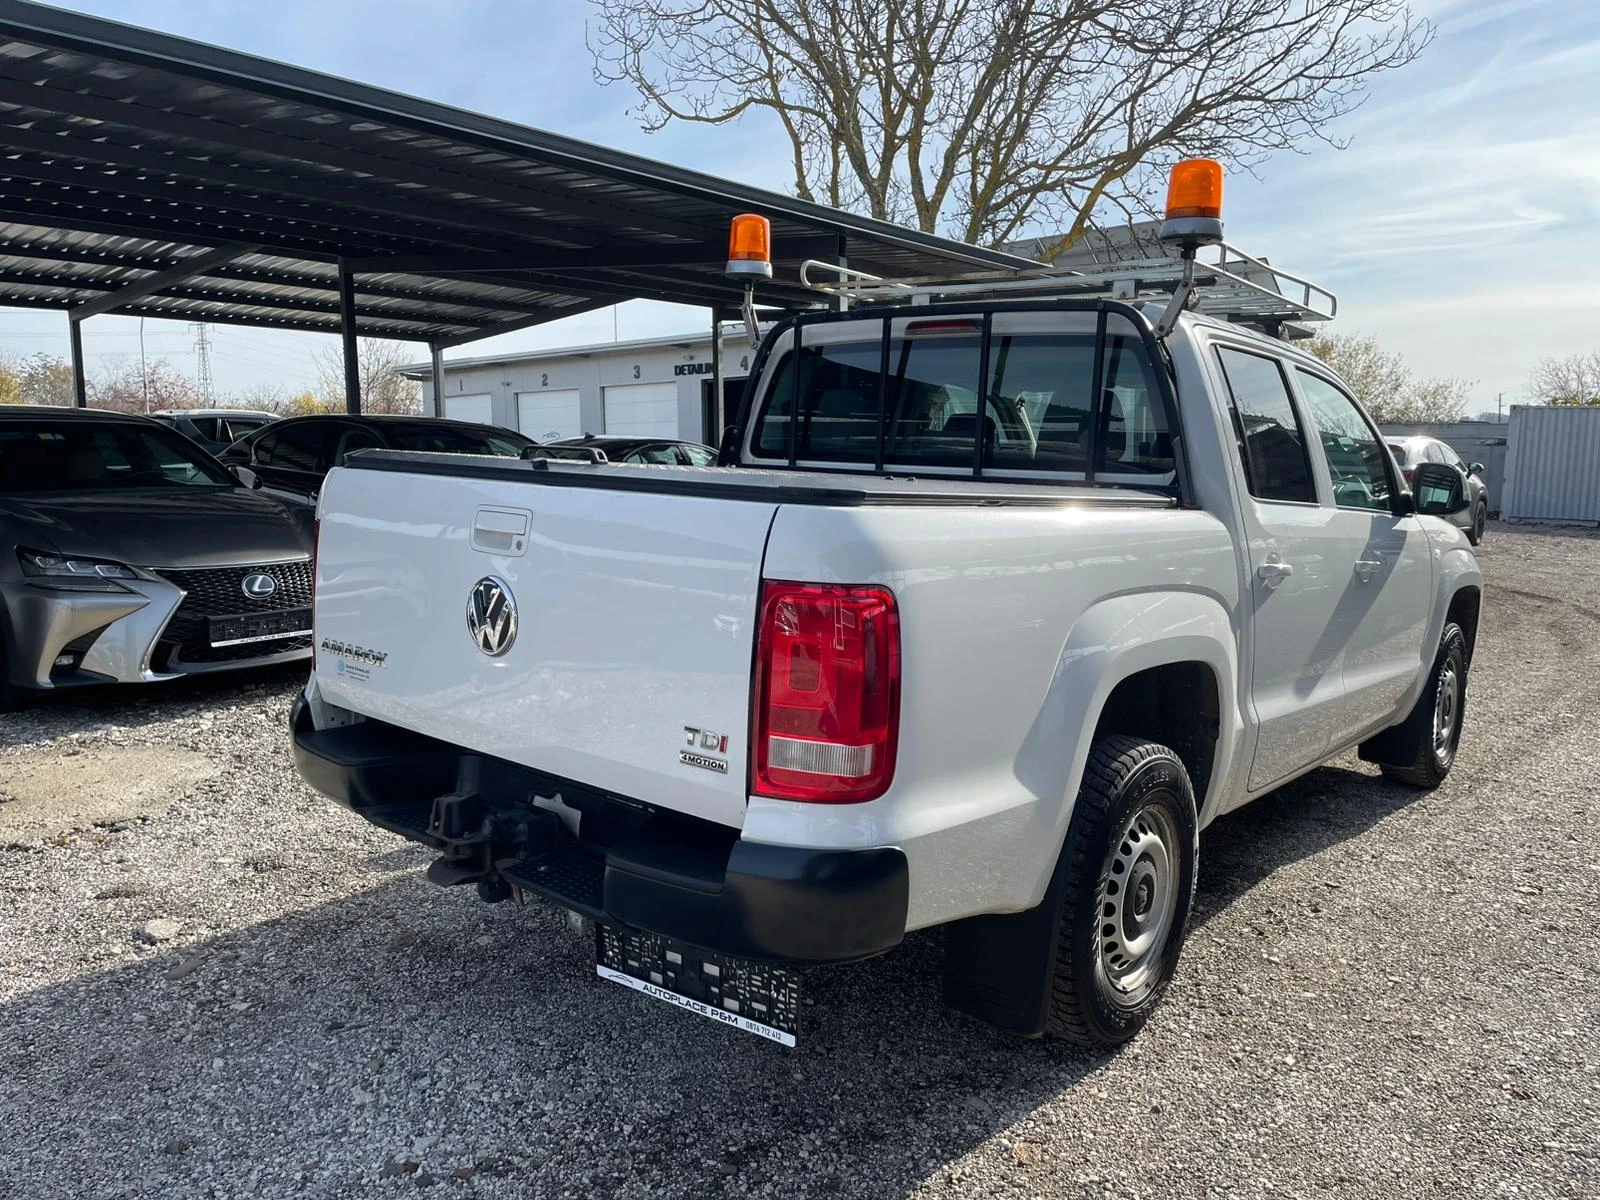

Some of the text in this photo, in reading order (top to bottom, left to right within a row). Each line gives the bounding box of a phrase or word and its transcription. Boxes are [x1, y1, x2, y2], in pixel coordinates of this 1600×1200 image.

[674, 362, 714, 376] DETAILIN
[740, 355, 749, 371] 4
[541, 373, 548, 386] 2
[633, 365, 641, 379] 3
[321, 638, 389, 669] AMAROK
[684, 726, 728, 753] TDI
[681, 754, 725, 770] 4MOTION
[642, 984, 708, 1015] AUTOPLACE
[710, 1007, 738, 1025] P&M
